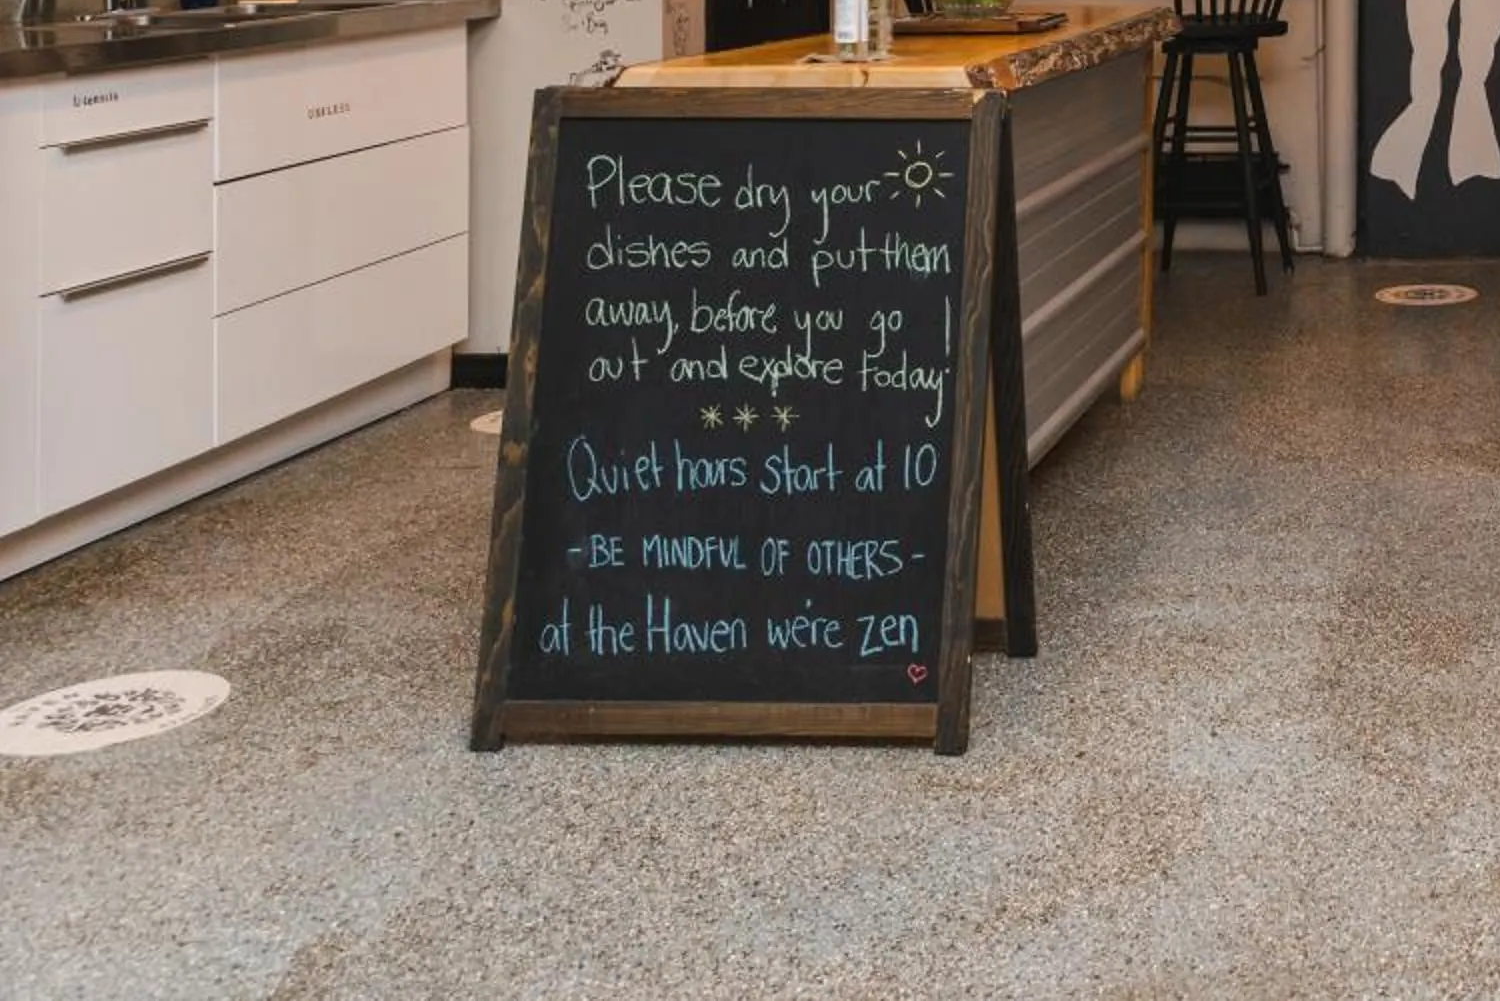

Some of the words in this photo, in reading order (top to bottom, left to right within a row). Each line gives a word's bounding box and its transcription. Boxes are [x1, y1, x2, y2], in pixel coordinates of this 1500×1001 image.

[587, 154, 722, 208] Please
[735, 164, 790, 237] dry
[811, 180, 880, 247] your
[587, 223, 711, 269] dishes
[732, 235, 788, 269] and
[812, 228, 872, 287] put
[874, 232, 950, 277] them
[690, 287, 777, 333] before
[794, 311, 843, 357] you
[870, 310, 906, 357] go
[589, 338, 648, 381] out
[668, 343, 728, 382] and
[738, 345, 843, 397] explore
[568, 435, 663, 501] Quiet
[675, 439, 746, 491] hours
[855, 439, 886, 491] at
[904, 444, 936, 489] 10
[643, 535, 746, 569] MINDFUL
[762, 537, 789, 575] OF
[540, 598, 570, 655] at
[585, 604, 634, 655] the
[647, 594, 747, 653] Haven
[768, 599, 843, 649] we're
[856, 615, 918, 657] zen
